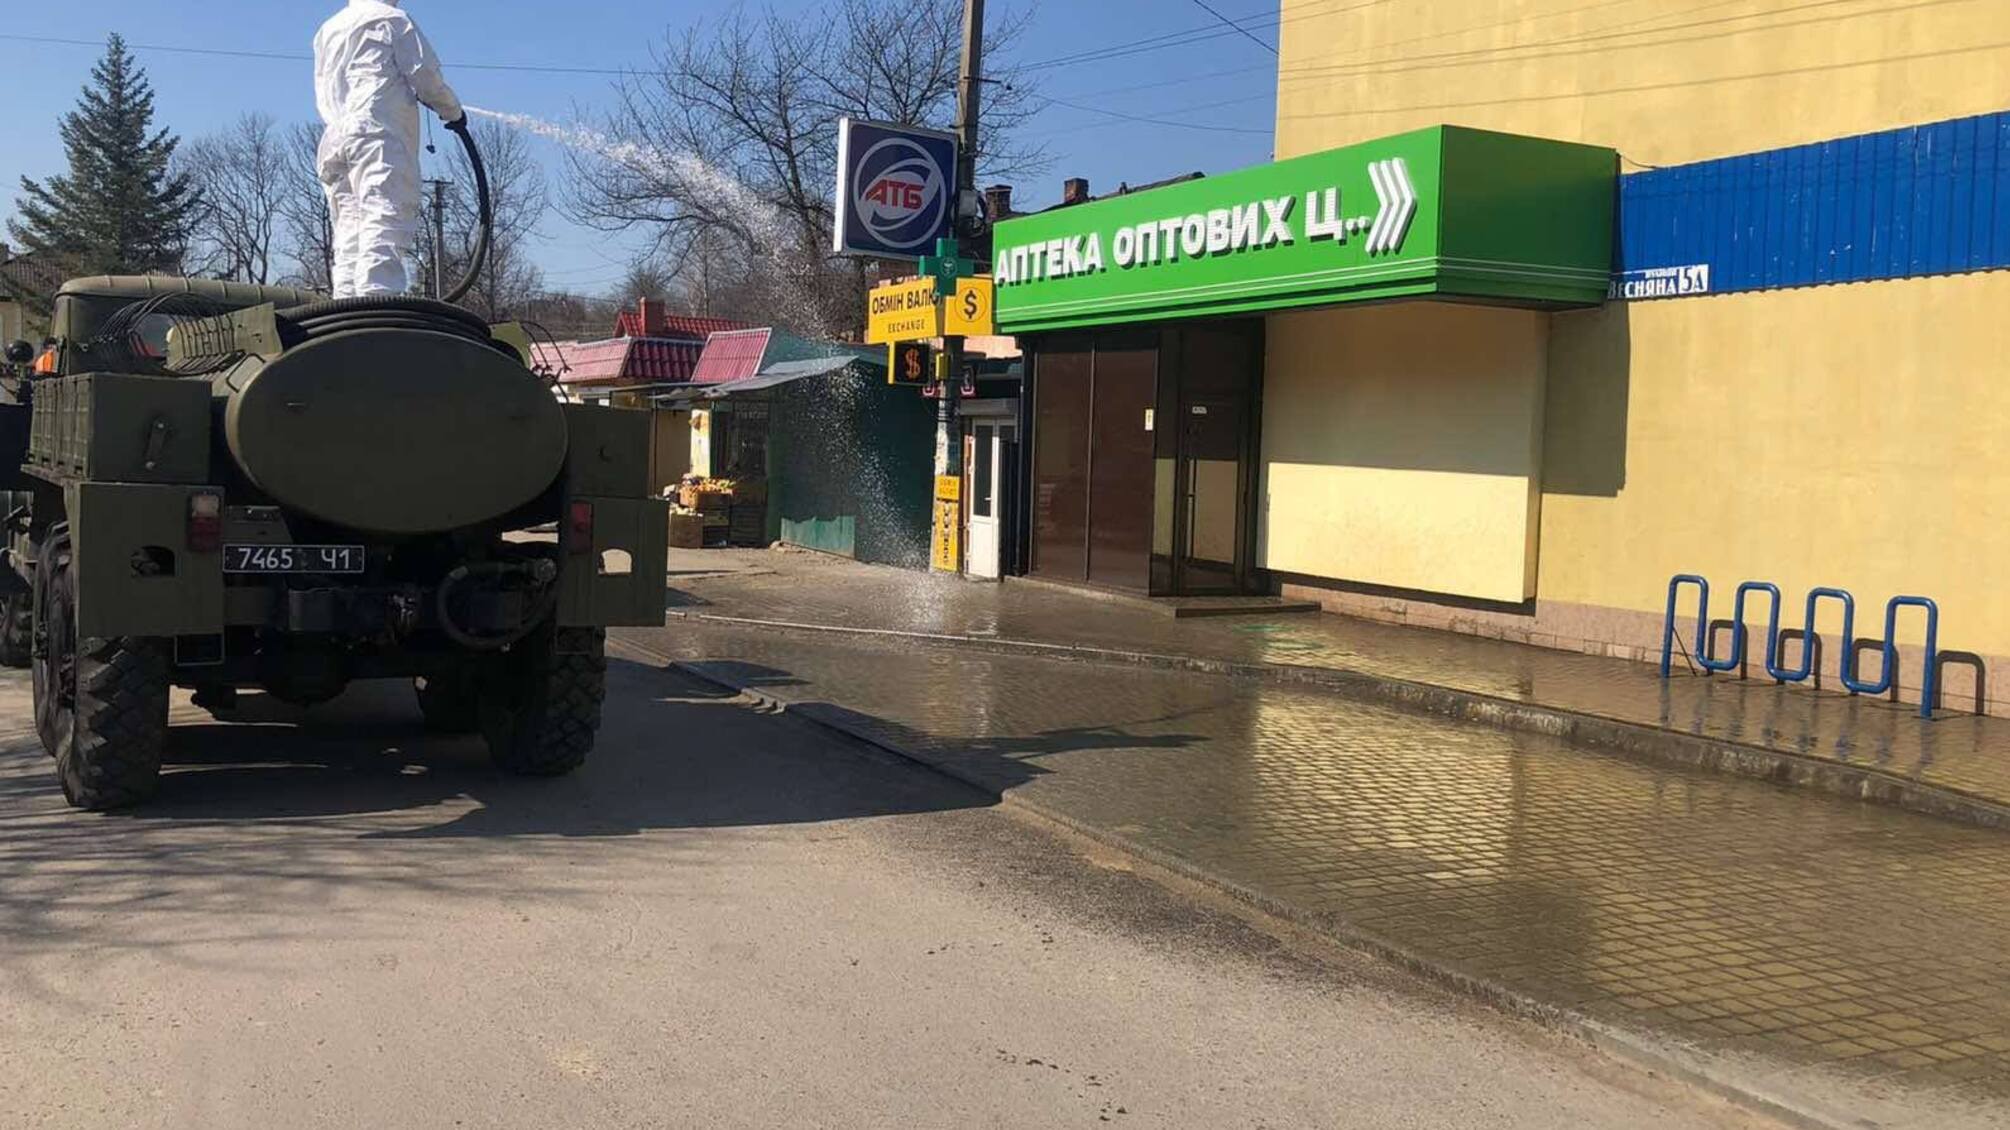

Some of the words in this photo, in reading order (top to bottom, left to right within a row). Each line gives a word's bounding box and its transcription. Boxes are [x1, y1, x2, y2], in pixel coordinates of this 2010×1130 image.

[865, 178, 925, 210] АТБ
[993, 232, 1105, 285] АПТЕКА
[1113, 196, 1295, 269] ОПТОВИХ
[872, 292, 904, 315] ОБМІН
[888, 319, 925, 334] EXCHANGE
[238, 547, 293, 570] 7465
